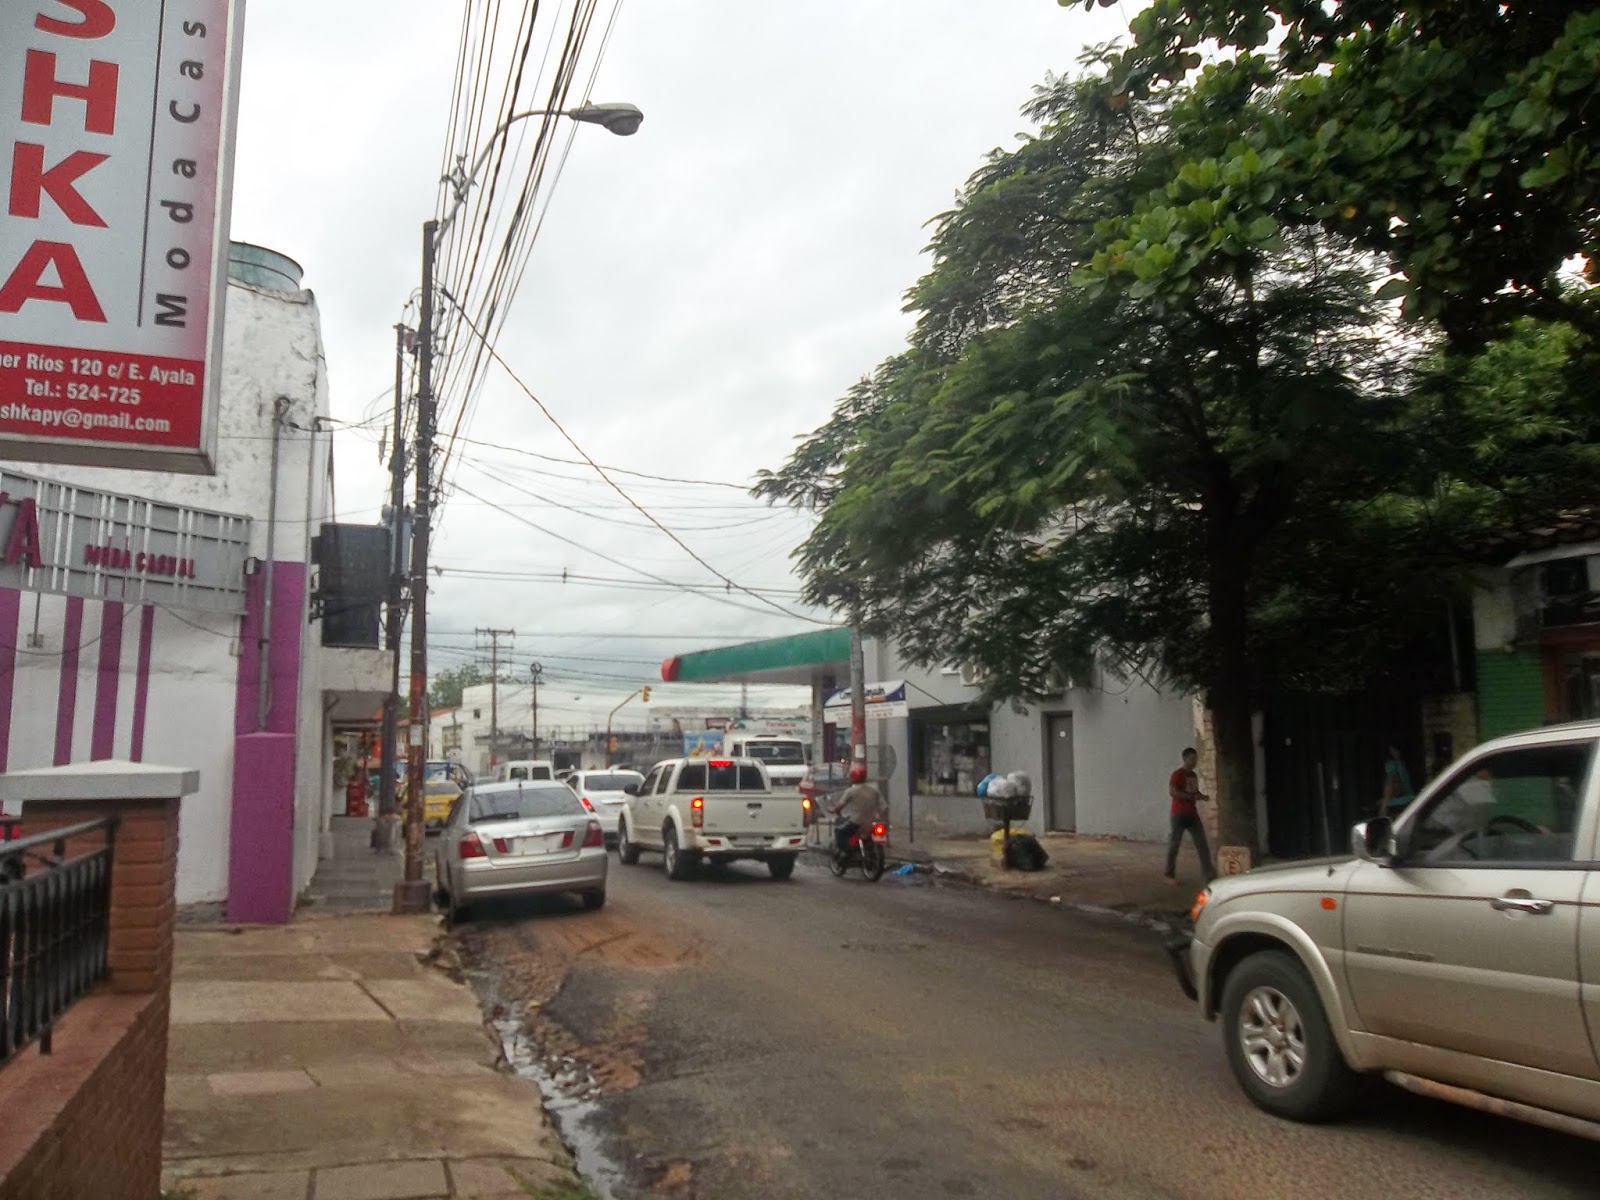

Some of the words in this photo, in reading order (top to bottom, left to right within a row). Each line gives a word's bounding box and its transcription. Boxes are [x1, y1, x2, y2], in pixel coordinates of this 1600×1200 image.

[154, 157, 197, 328] Moda
[71, 358, 103, 377] 120
[106, 362, 124, 380] c/
[128, 365, 144, 380] E.
[149, 366, 195, 386] Ayala
[25, 378, 61, 397] Tel.:
[66, 383, 141, 405] 524-725
[84, 543, 131, 570] MODA
[135, 551, 196, 579] CASUAL
